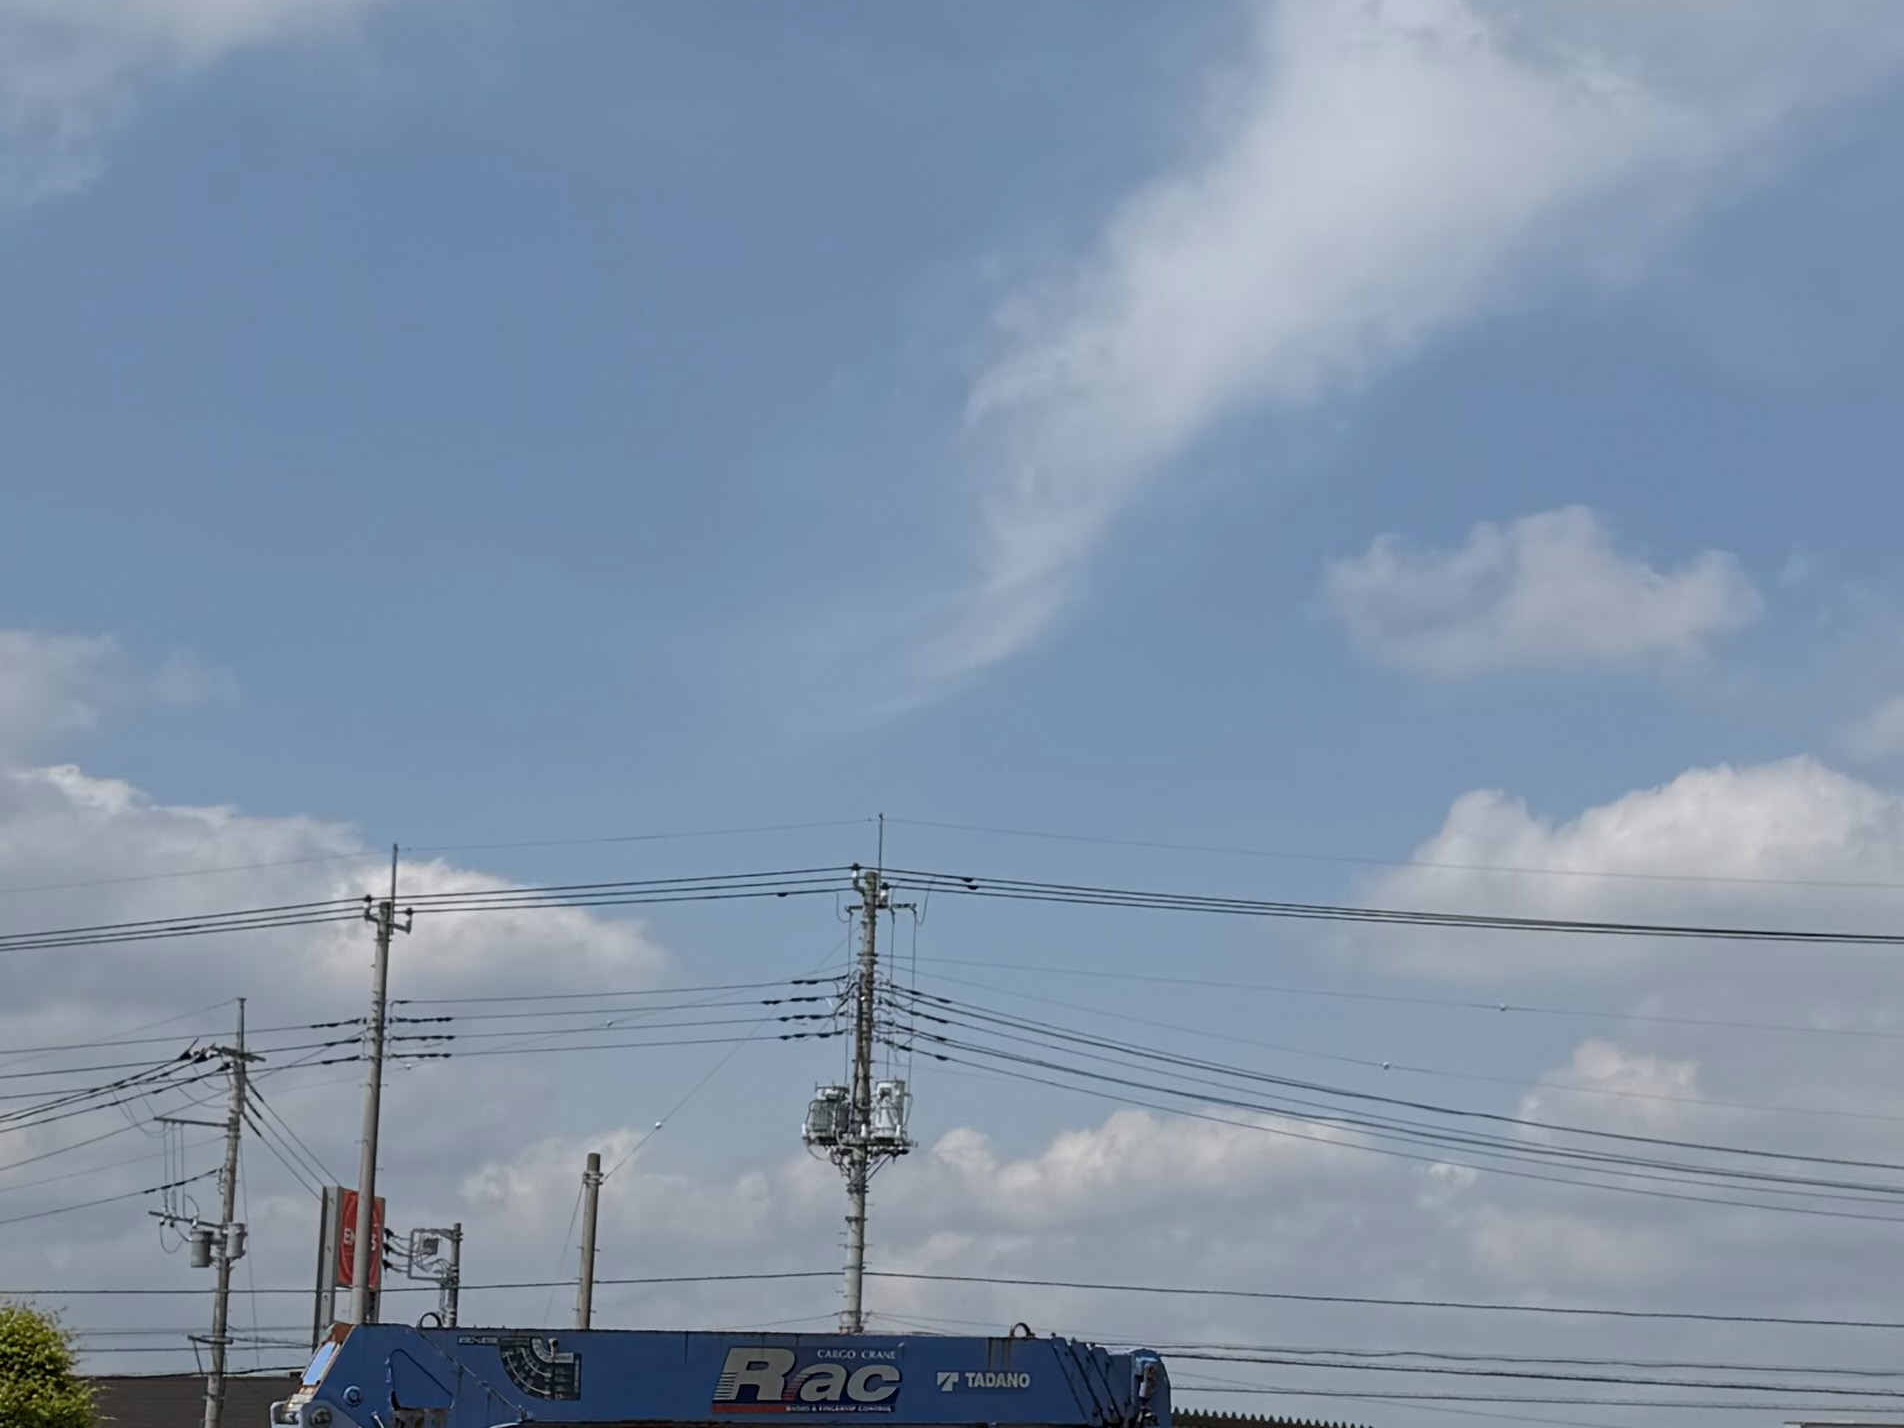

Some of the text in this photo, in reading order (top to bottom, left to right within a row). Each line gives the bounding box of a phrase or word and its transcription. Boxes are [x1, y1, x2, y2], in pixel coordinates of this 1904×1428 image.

[817, 1349, 896, 1360] CARGO CRANE
[713, 1347, 900, 1402] Rac
[965, 1372, 1031, 1388] TADANO
